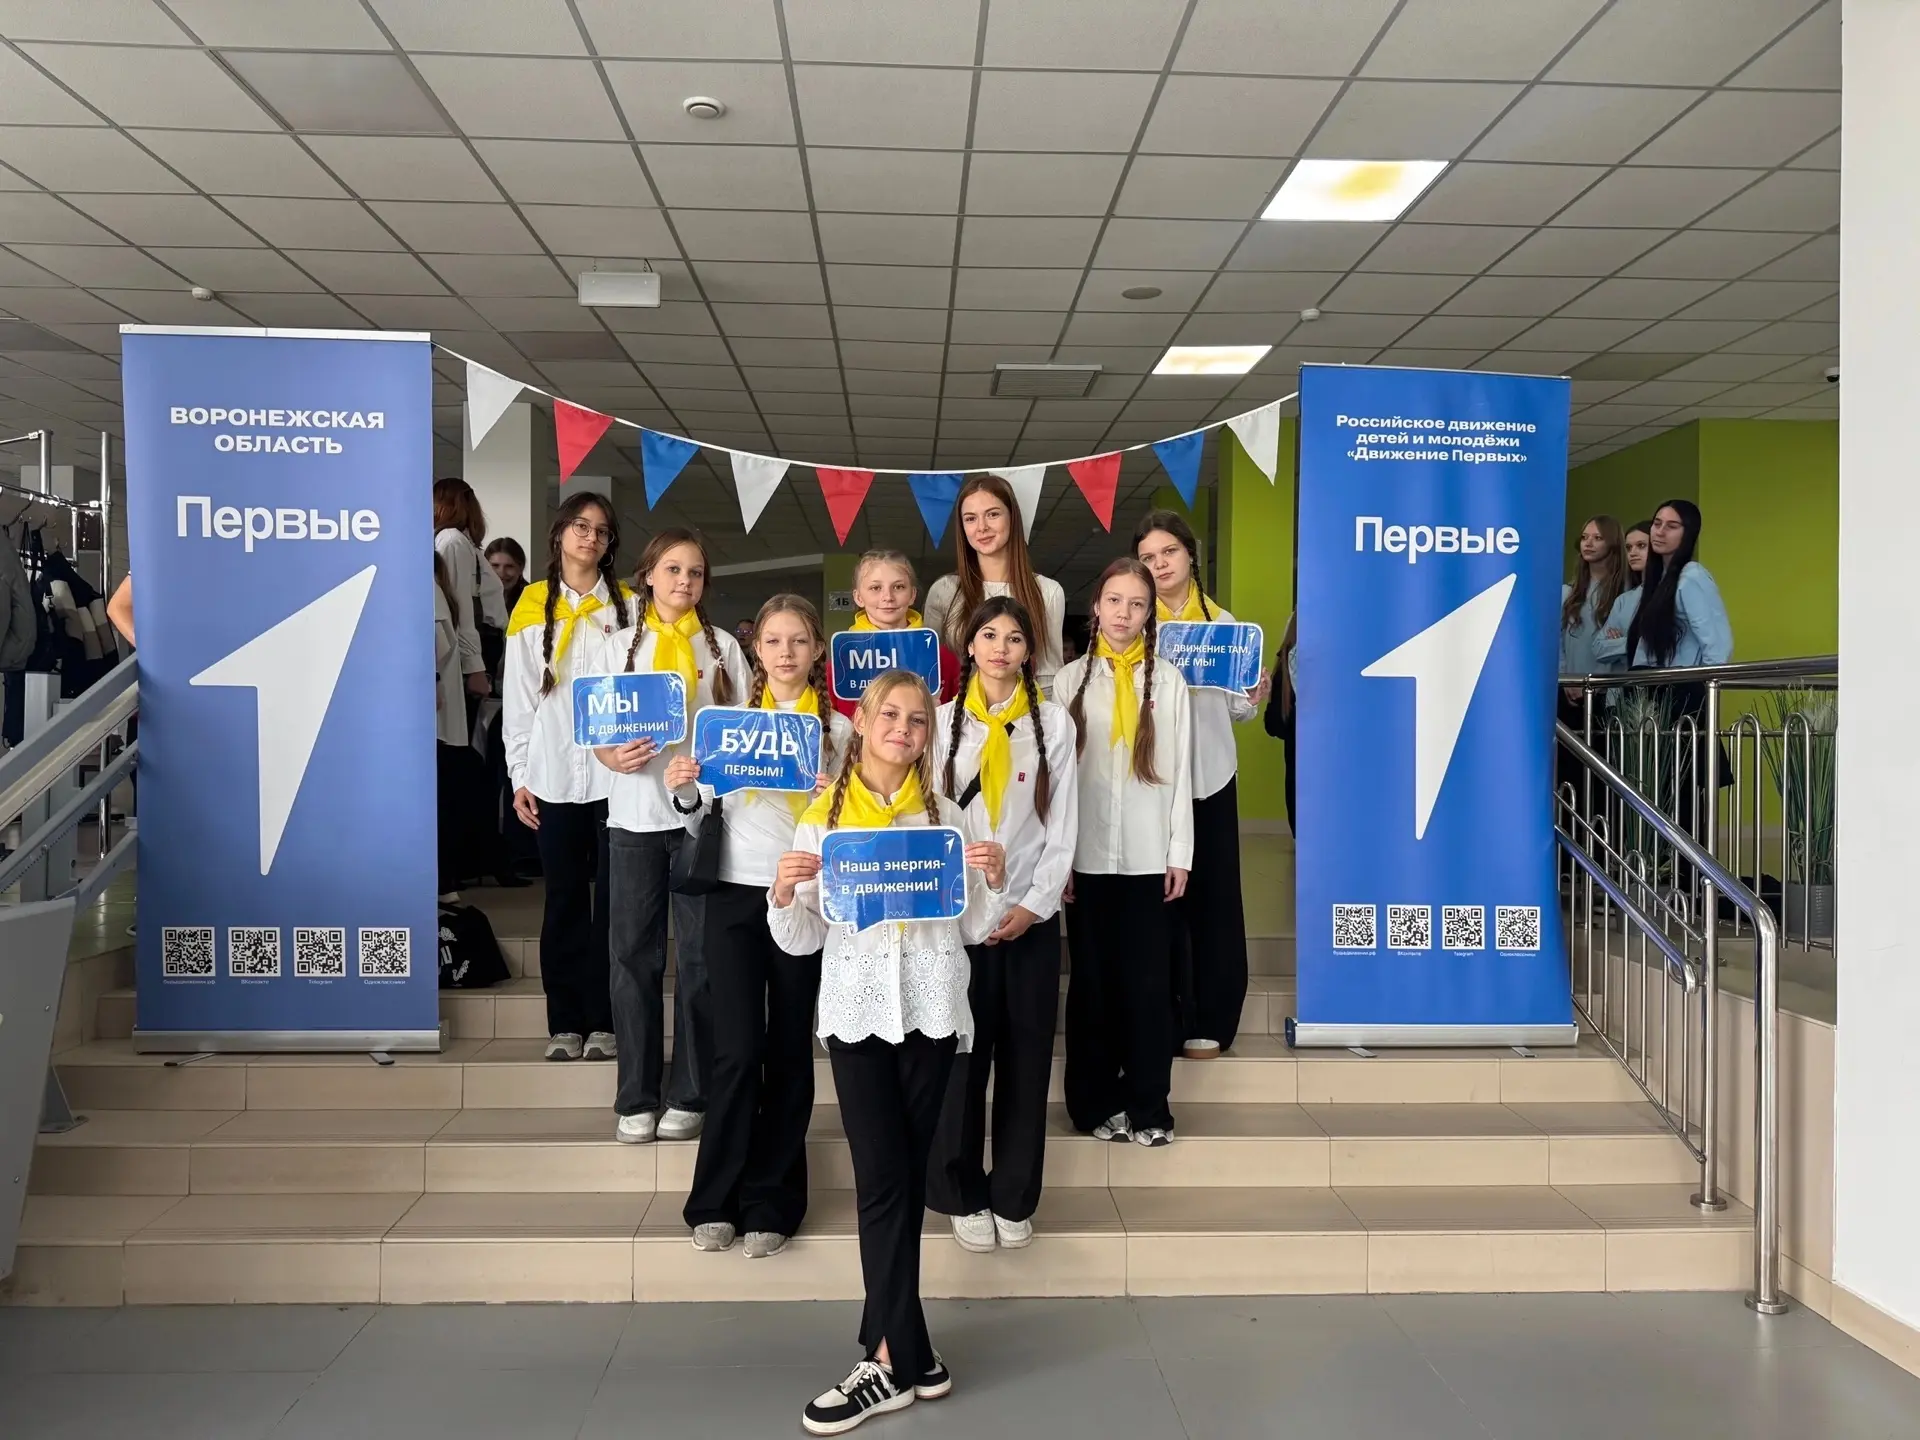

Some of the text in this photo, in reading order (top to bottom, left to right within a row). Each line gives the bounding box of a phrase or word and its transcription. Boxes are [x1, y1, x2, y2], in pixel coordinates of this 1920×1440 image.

[169, 406, 385, 429] ВОРОНЕЖСКАЯ
[1335, 415, 1537, 433] Российское движение
[214, 433, 343, 454] ОБЛАСТЬ
[1356, 433, 1520, 448] детей и молодёжи
[1347, 447, 1528, 464] «Движение Первых»
[176, 495, 381, 553] Первые
[1355, 516, 1520, 564] Первые
[835, 597, 850, 606] 1Б
[849, 648, 897, 669] МЫ
[1172, 644, 1251, 656] ДВИЖЕНИЕ ТАМ,
[1192, 658, 1216, 667] МЫ!
[850, 679, 857, 689] В
[587, 691, 639, 716] МЫ
[588, 721, 669, 735] В ДВИЖЕНИИ!
[721, 729, 799, 760] БУДЬ
[724, 764, 784, 778] ПЕРВЫМ!
[839, 859, 946, 873] Наша энергия-
[841, 877, 939, 897] в движении!
